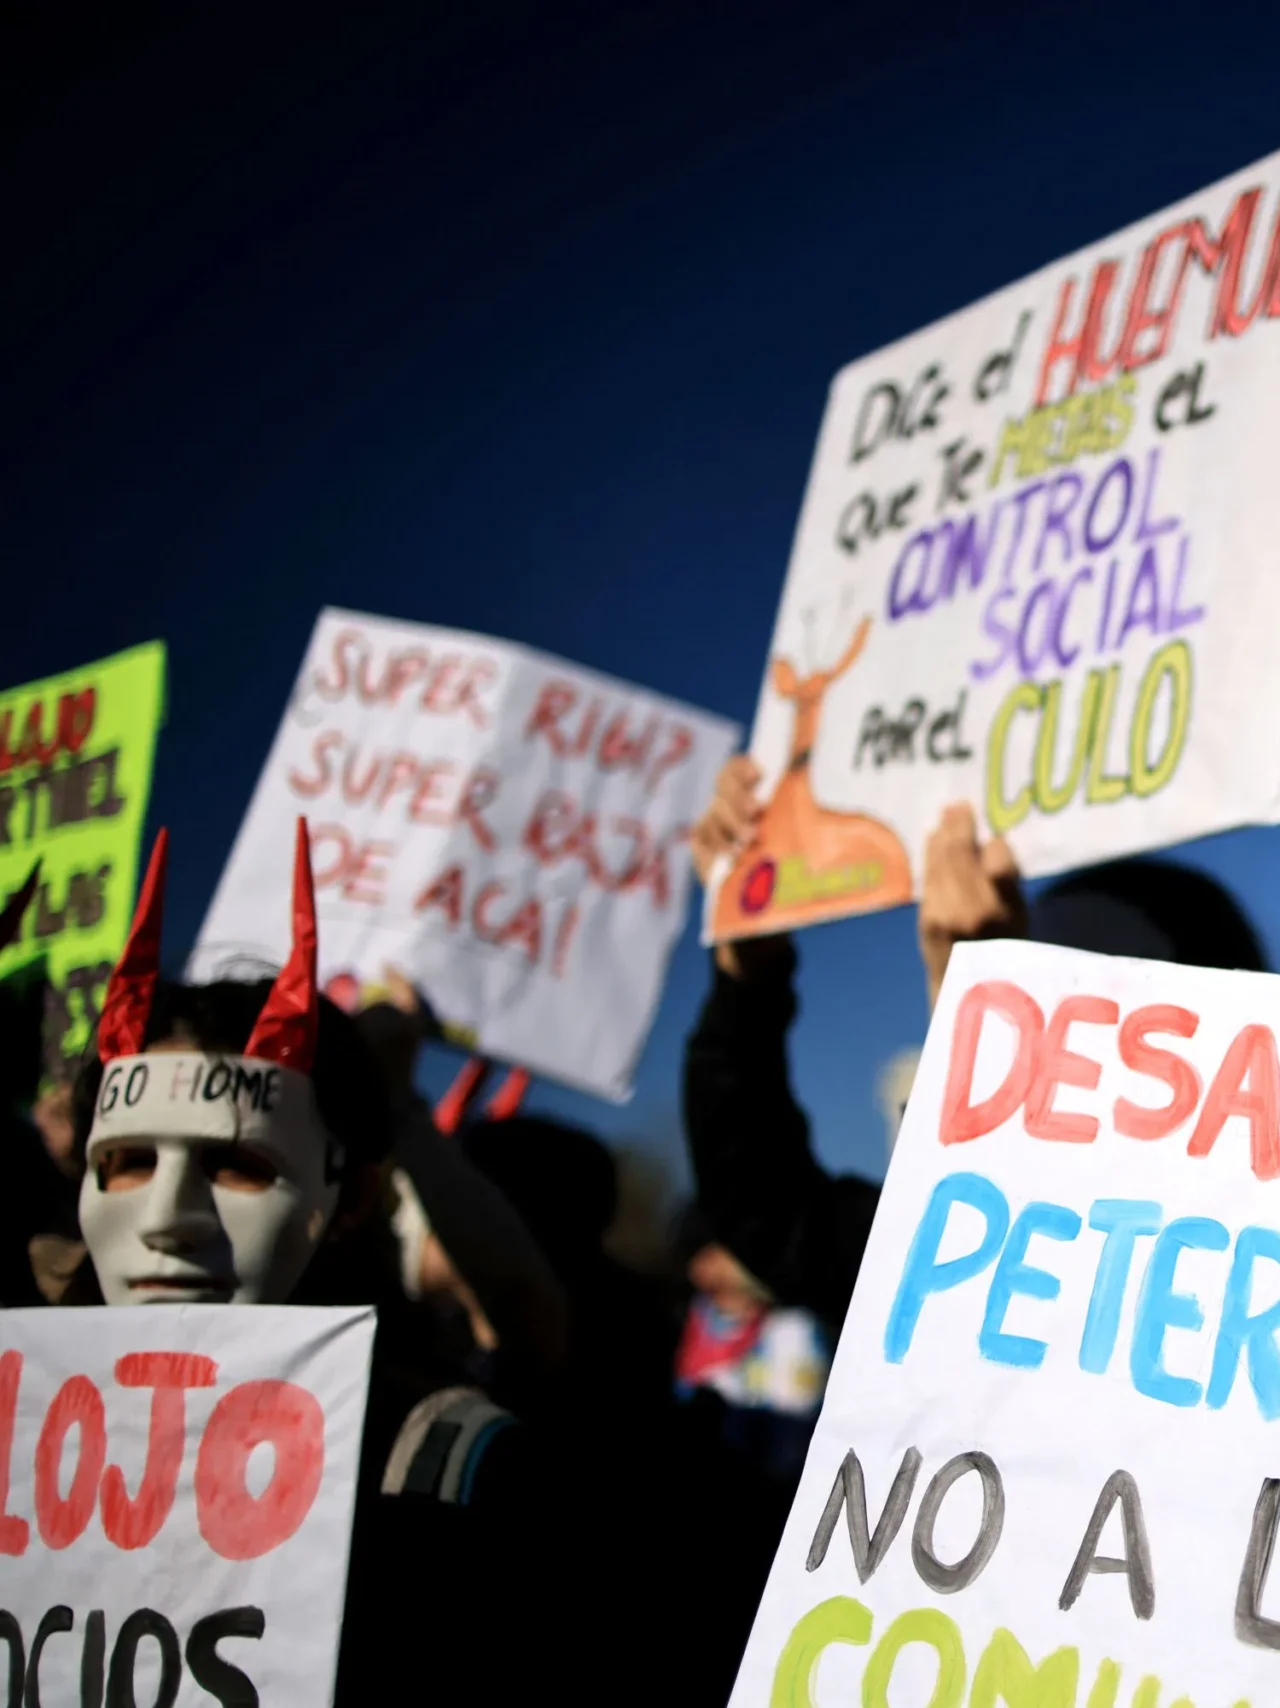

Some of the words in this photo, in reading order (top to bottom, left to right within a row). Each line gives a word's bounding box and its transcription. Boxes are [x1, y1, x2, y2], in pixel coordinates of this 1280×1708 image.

[887, 446, 1183, 623] CONTROL
[969, 535, 1206, 683] SOCIAL
[315, 627, 498, 731] SUPER
[984, 639, 1193, 837] CULO
[287, 729, 501, 853] SUPER
[308, 823, 398, 906] DE
[101, 1061, 149, 1113] GO
[169, 1056, 281, 1113] HOME
[805, 1446, 1004, 1595] NO
[1058, 1468, 1156, 1622] A
